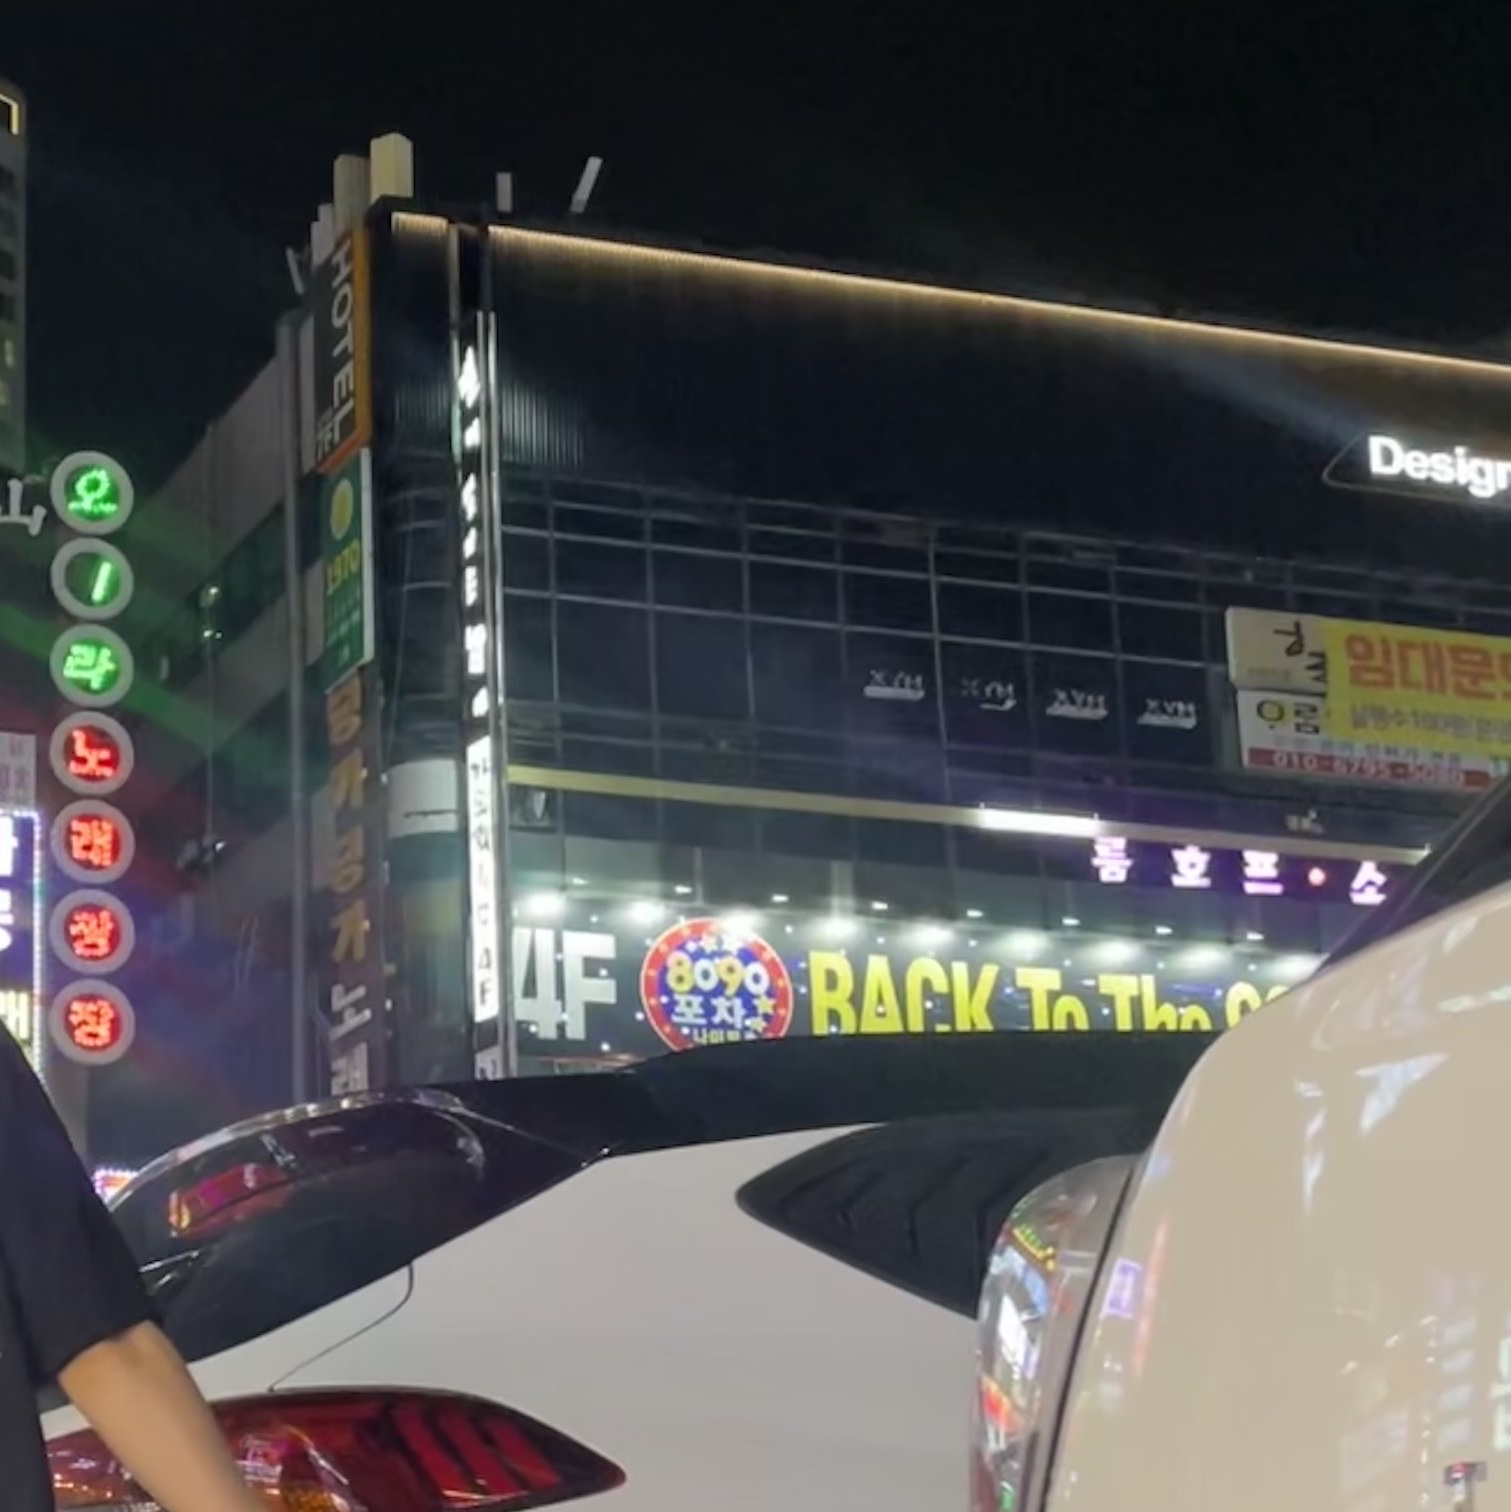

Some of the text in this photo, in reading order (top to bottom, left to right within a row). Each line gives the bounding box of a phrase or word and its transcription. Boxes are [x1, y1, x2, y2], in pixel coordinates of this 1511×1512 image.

[331, 238, 355, 446] HOTEL
[1344, 634, 1511, 699] 임대문
[666, 950, 770, 997] 8090
[808, 951, 999, 1035] BACK
